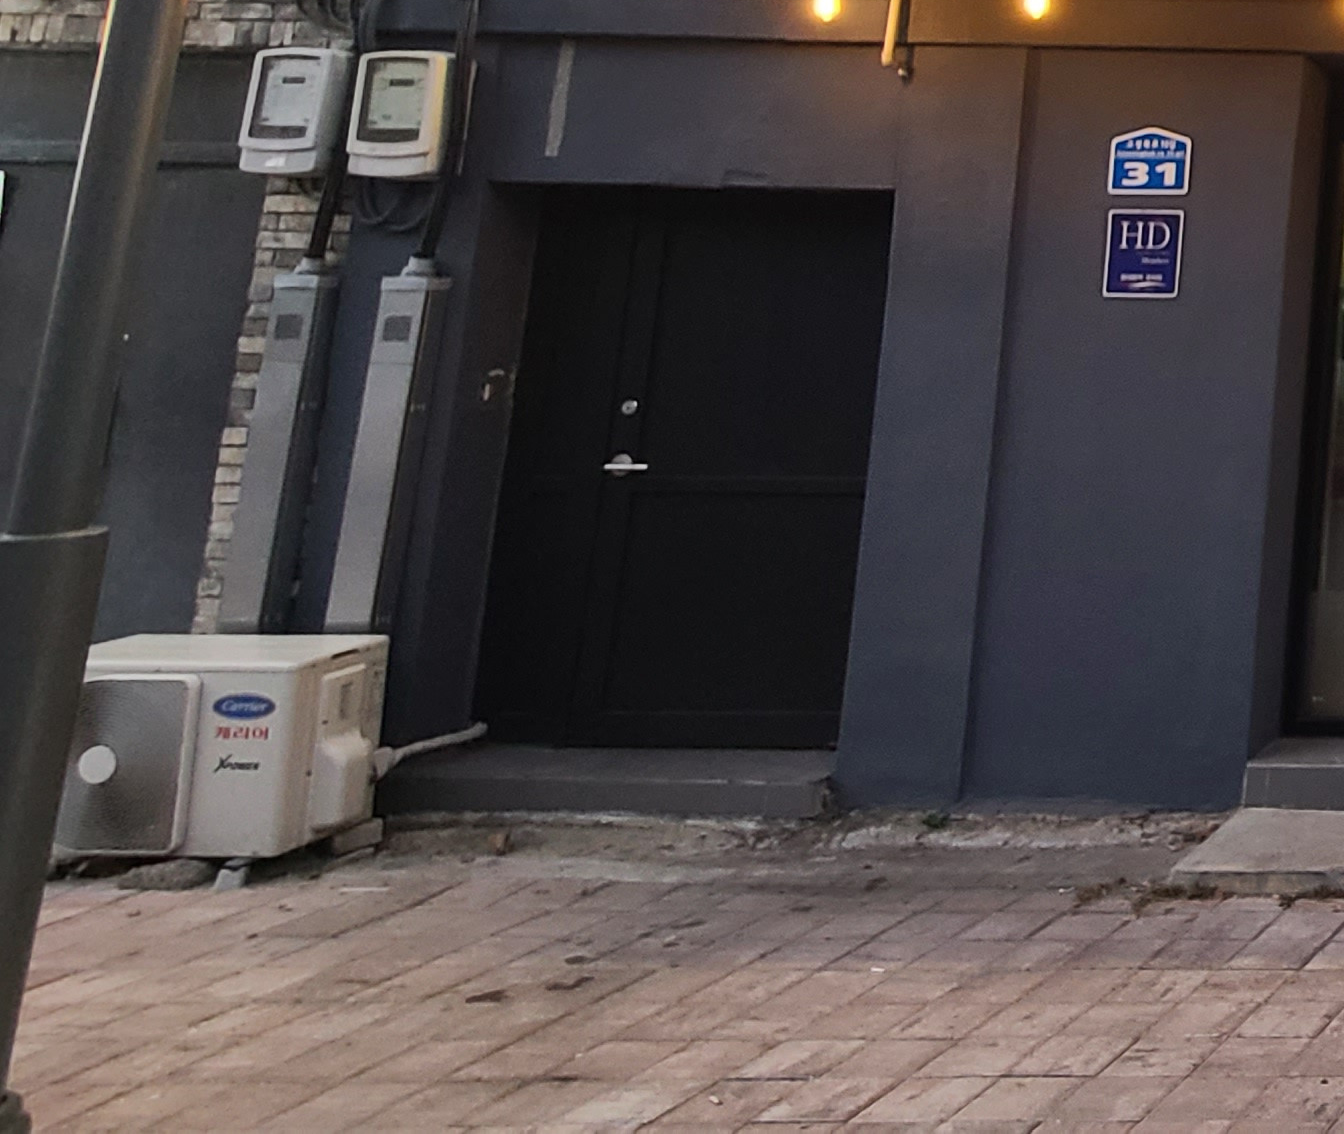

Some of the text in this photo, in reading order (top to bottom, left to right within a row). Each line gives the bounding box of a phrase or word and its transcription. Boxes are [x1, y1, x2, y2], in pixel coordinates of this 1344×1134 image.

[1121, 161, 1177, 187] 31
[1119, 220, 1171, 250] HD
[221, 699, 269, 713] Carrier
